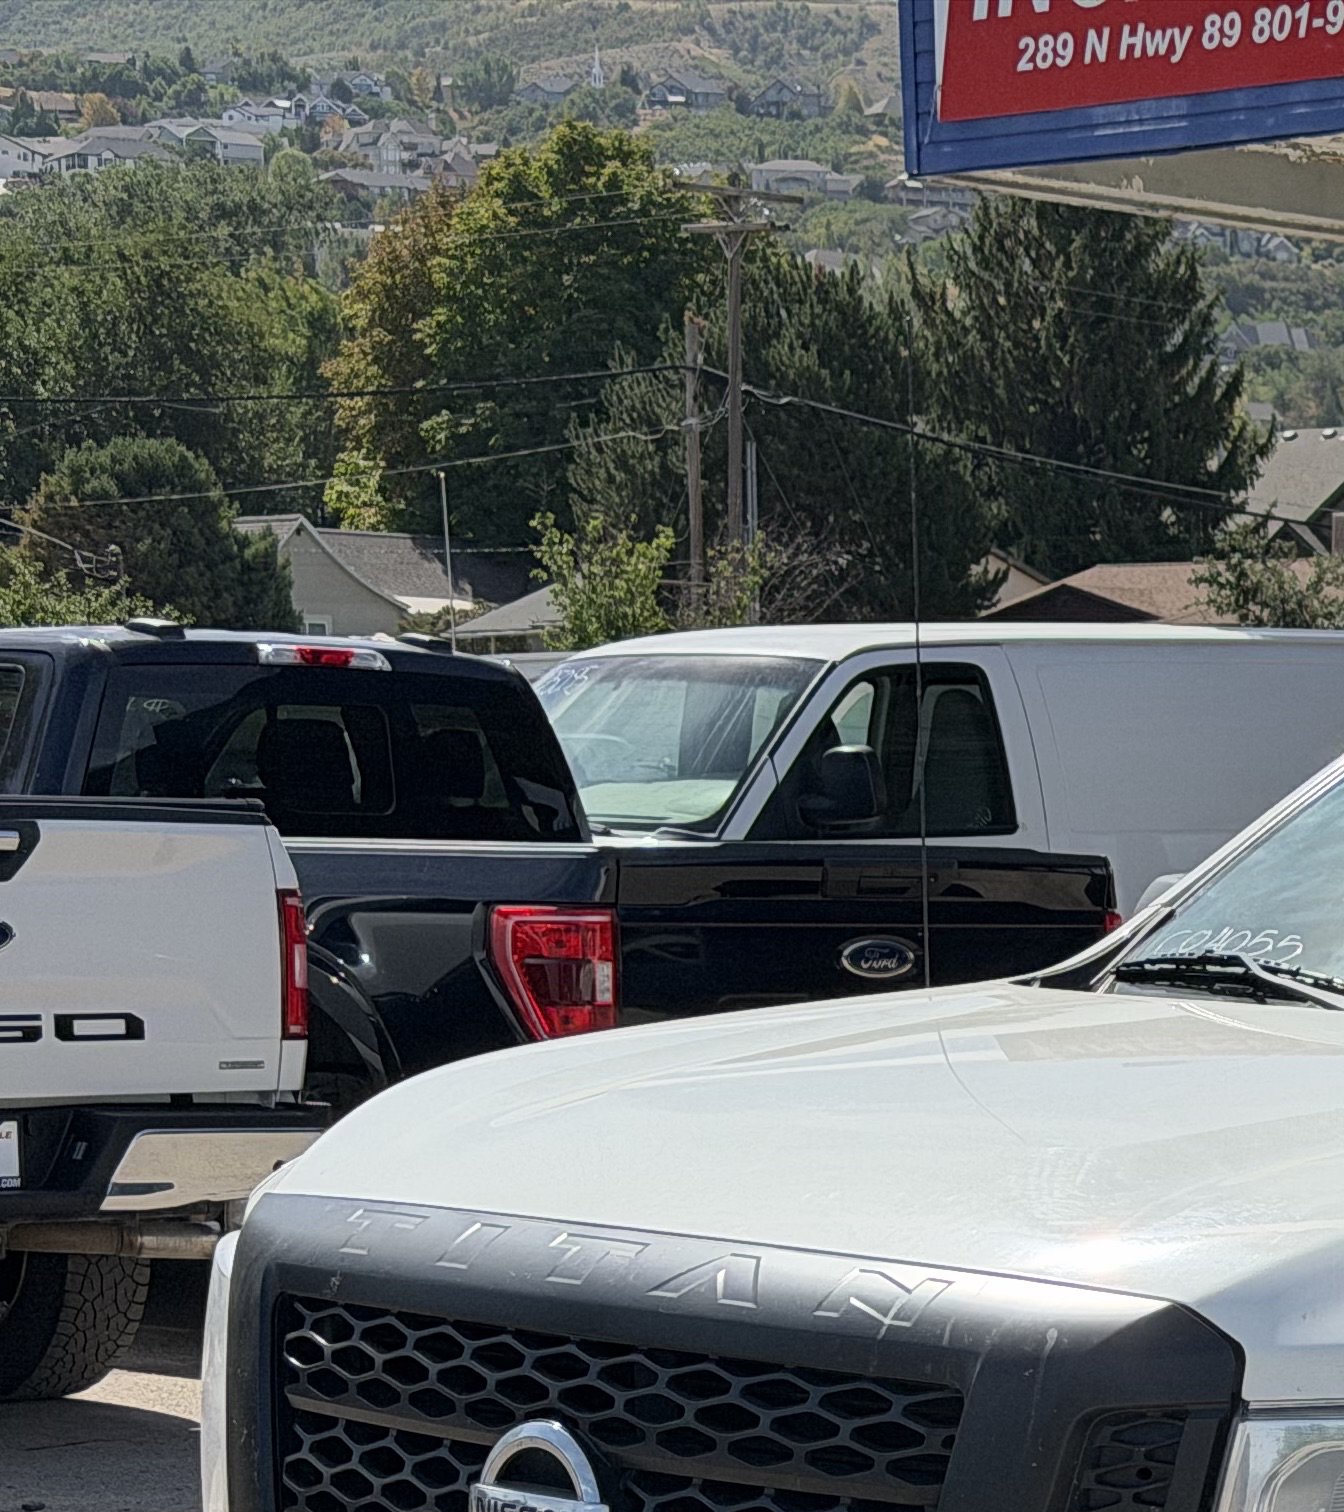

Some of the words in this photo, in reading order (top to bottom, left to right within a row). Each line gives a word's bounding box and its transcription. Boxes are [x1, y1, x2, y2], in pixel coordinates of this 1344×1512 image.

[1017, 31, 1074, 72] 289
[1083, 26, 1111, 65] N
[1119, 22, 1193, 64] Hwy
[1202, 11, 1242, 50] 89
[860, 946, 899, 969] Ford
[339, 1207, 955, 1327] TITAN
